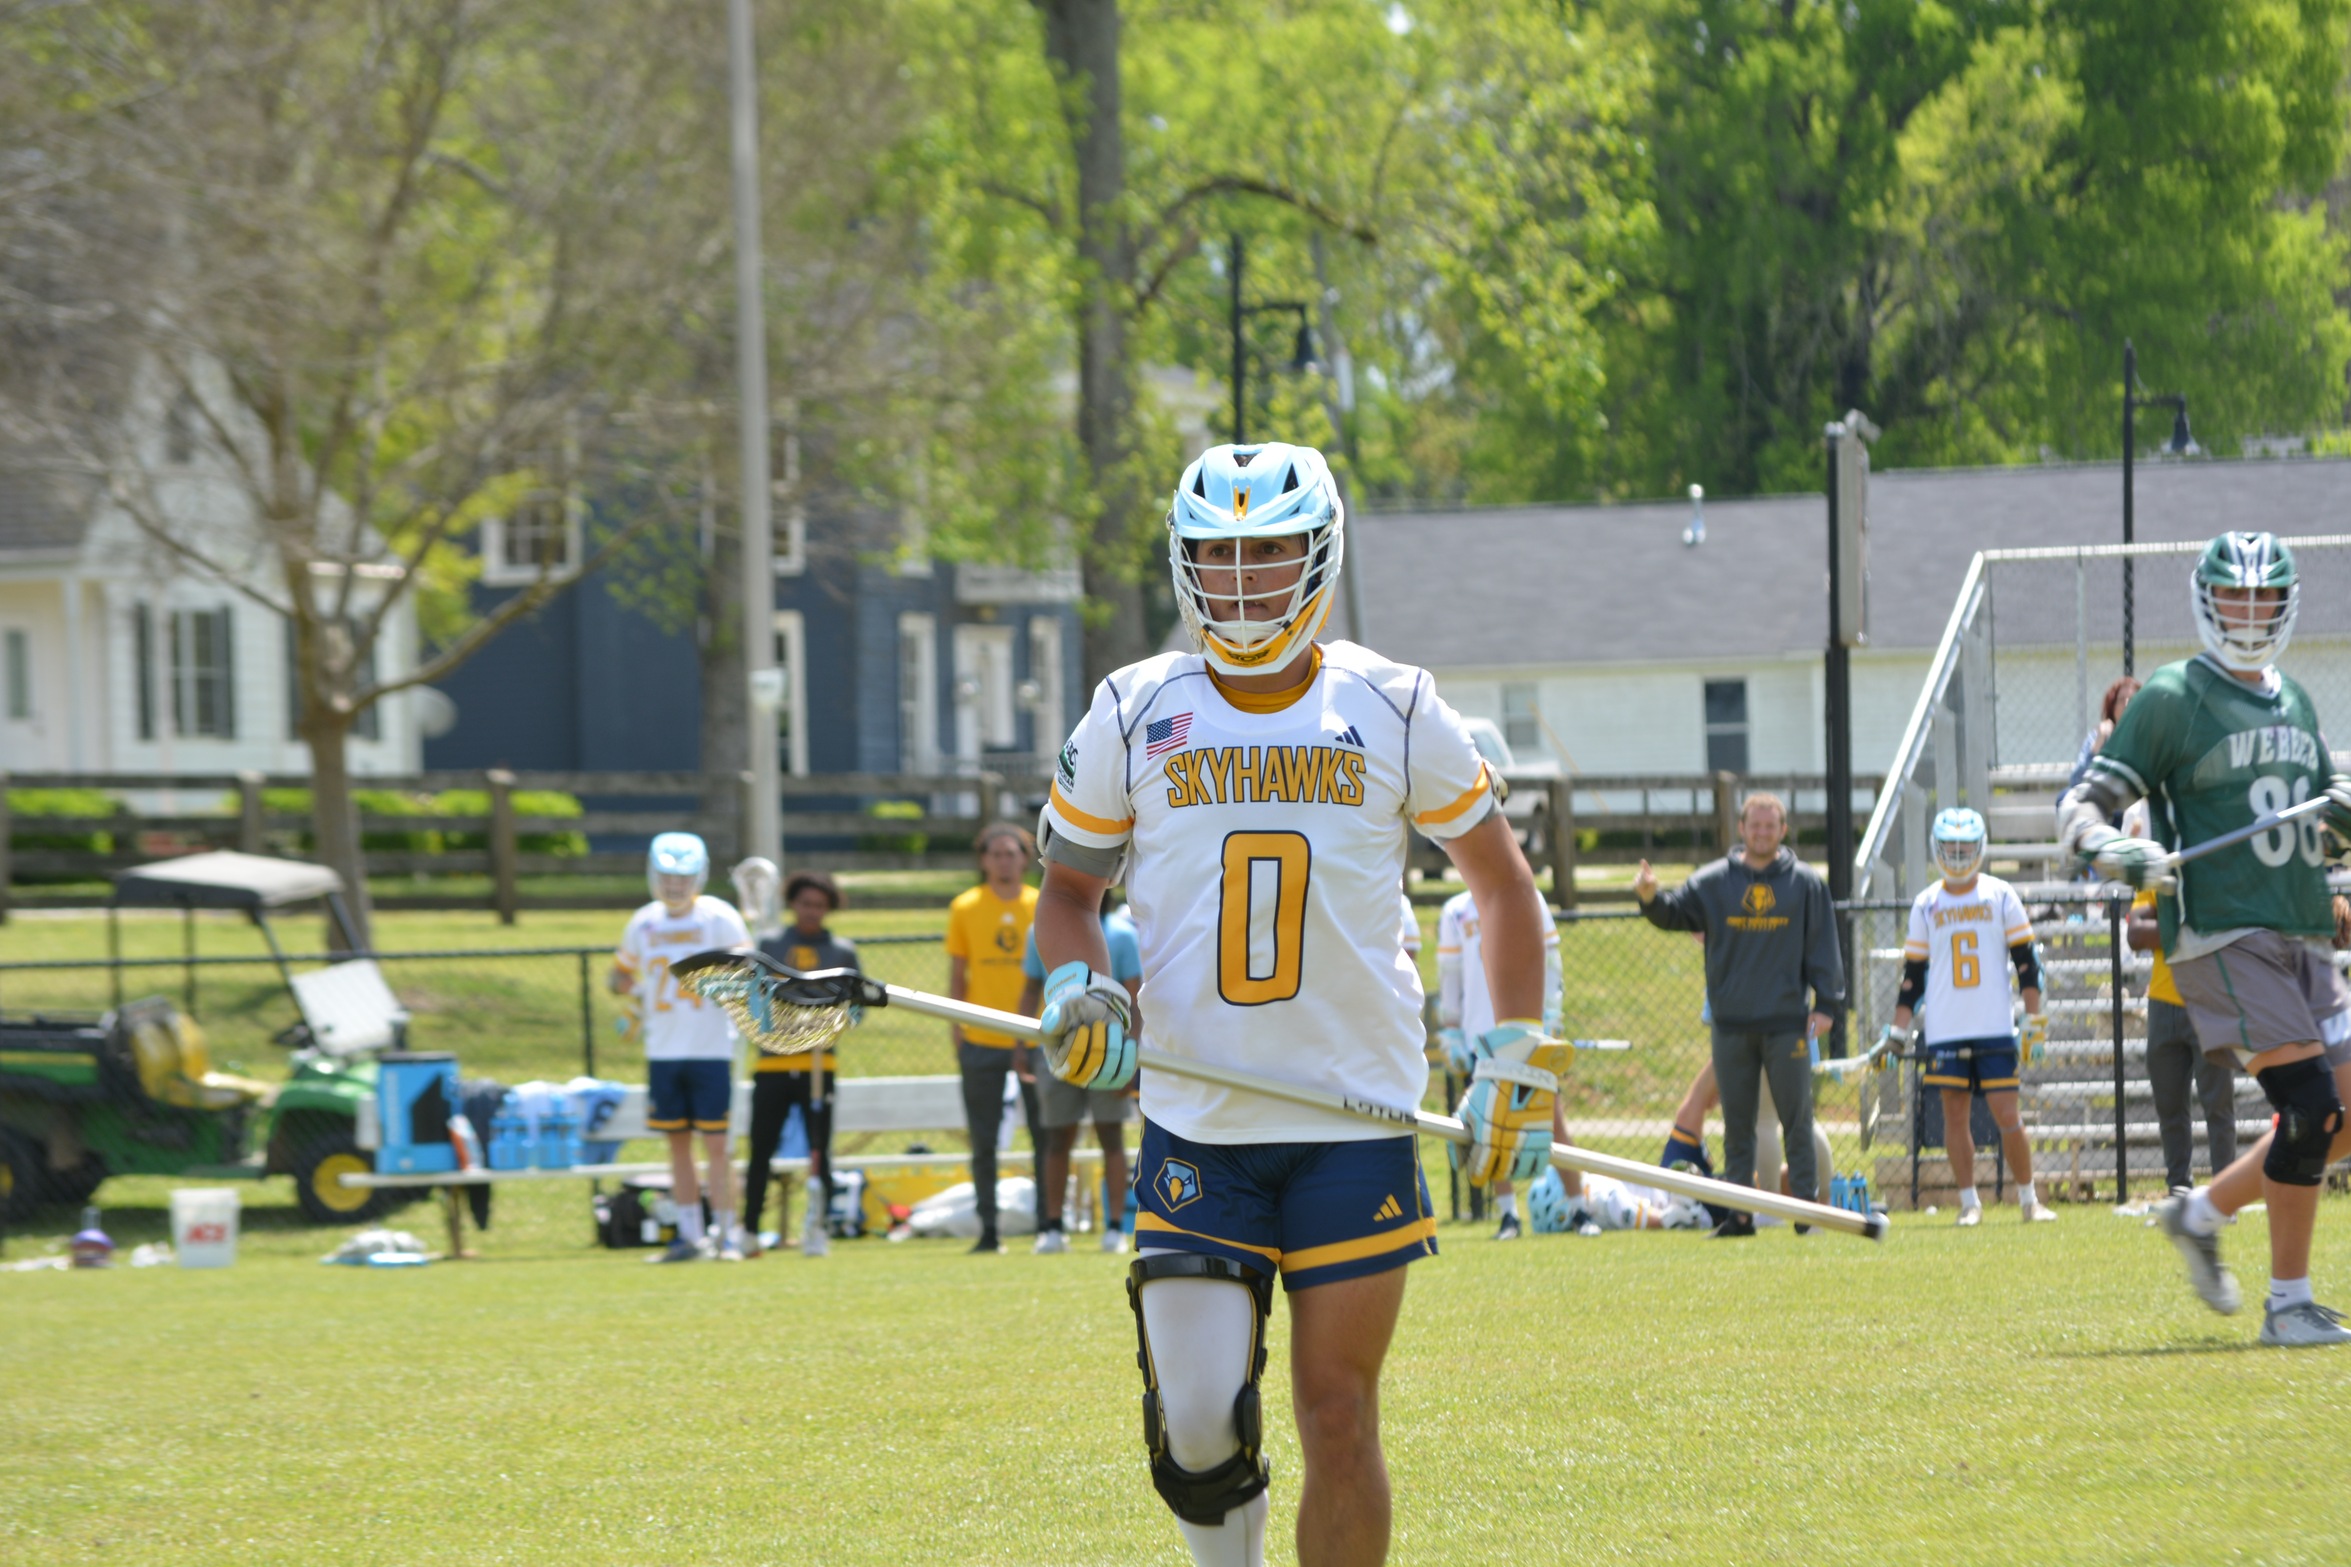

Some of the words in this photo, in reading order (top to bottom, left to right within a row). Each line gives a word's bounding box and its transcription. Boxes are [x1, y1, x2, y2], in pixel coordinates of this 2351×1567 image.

[1164, 746, 1366, 808] SKYHAWKS
[1217, 830, 1312, 1006] 0
[1951, 931, 1981, 988] 6
